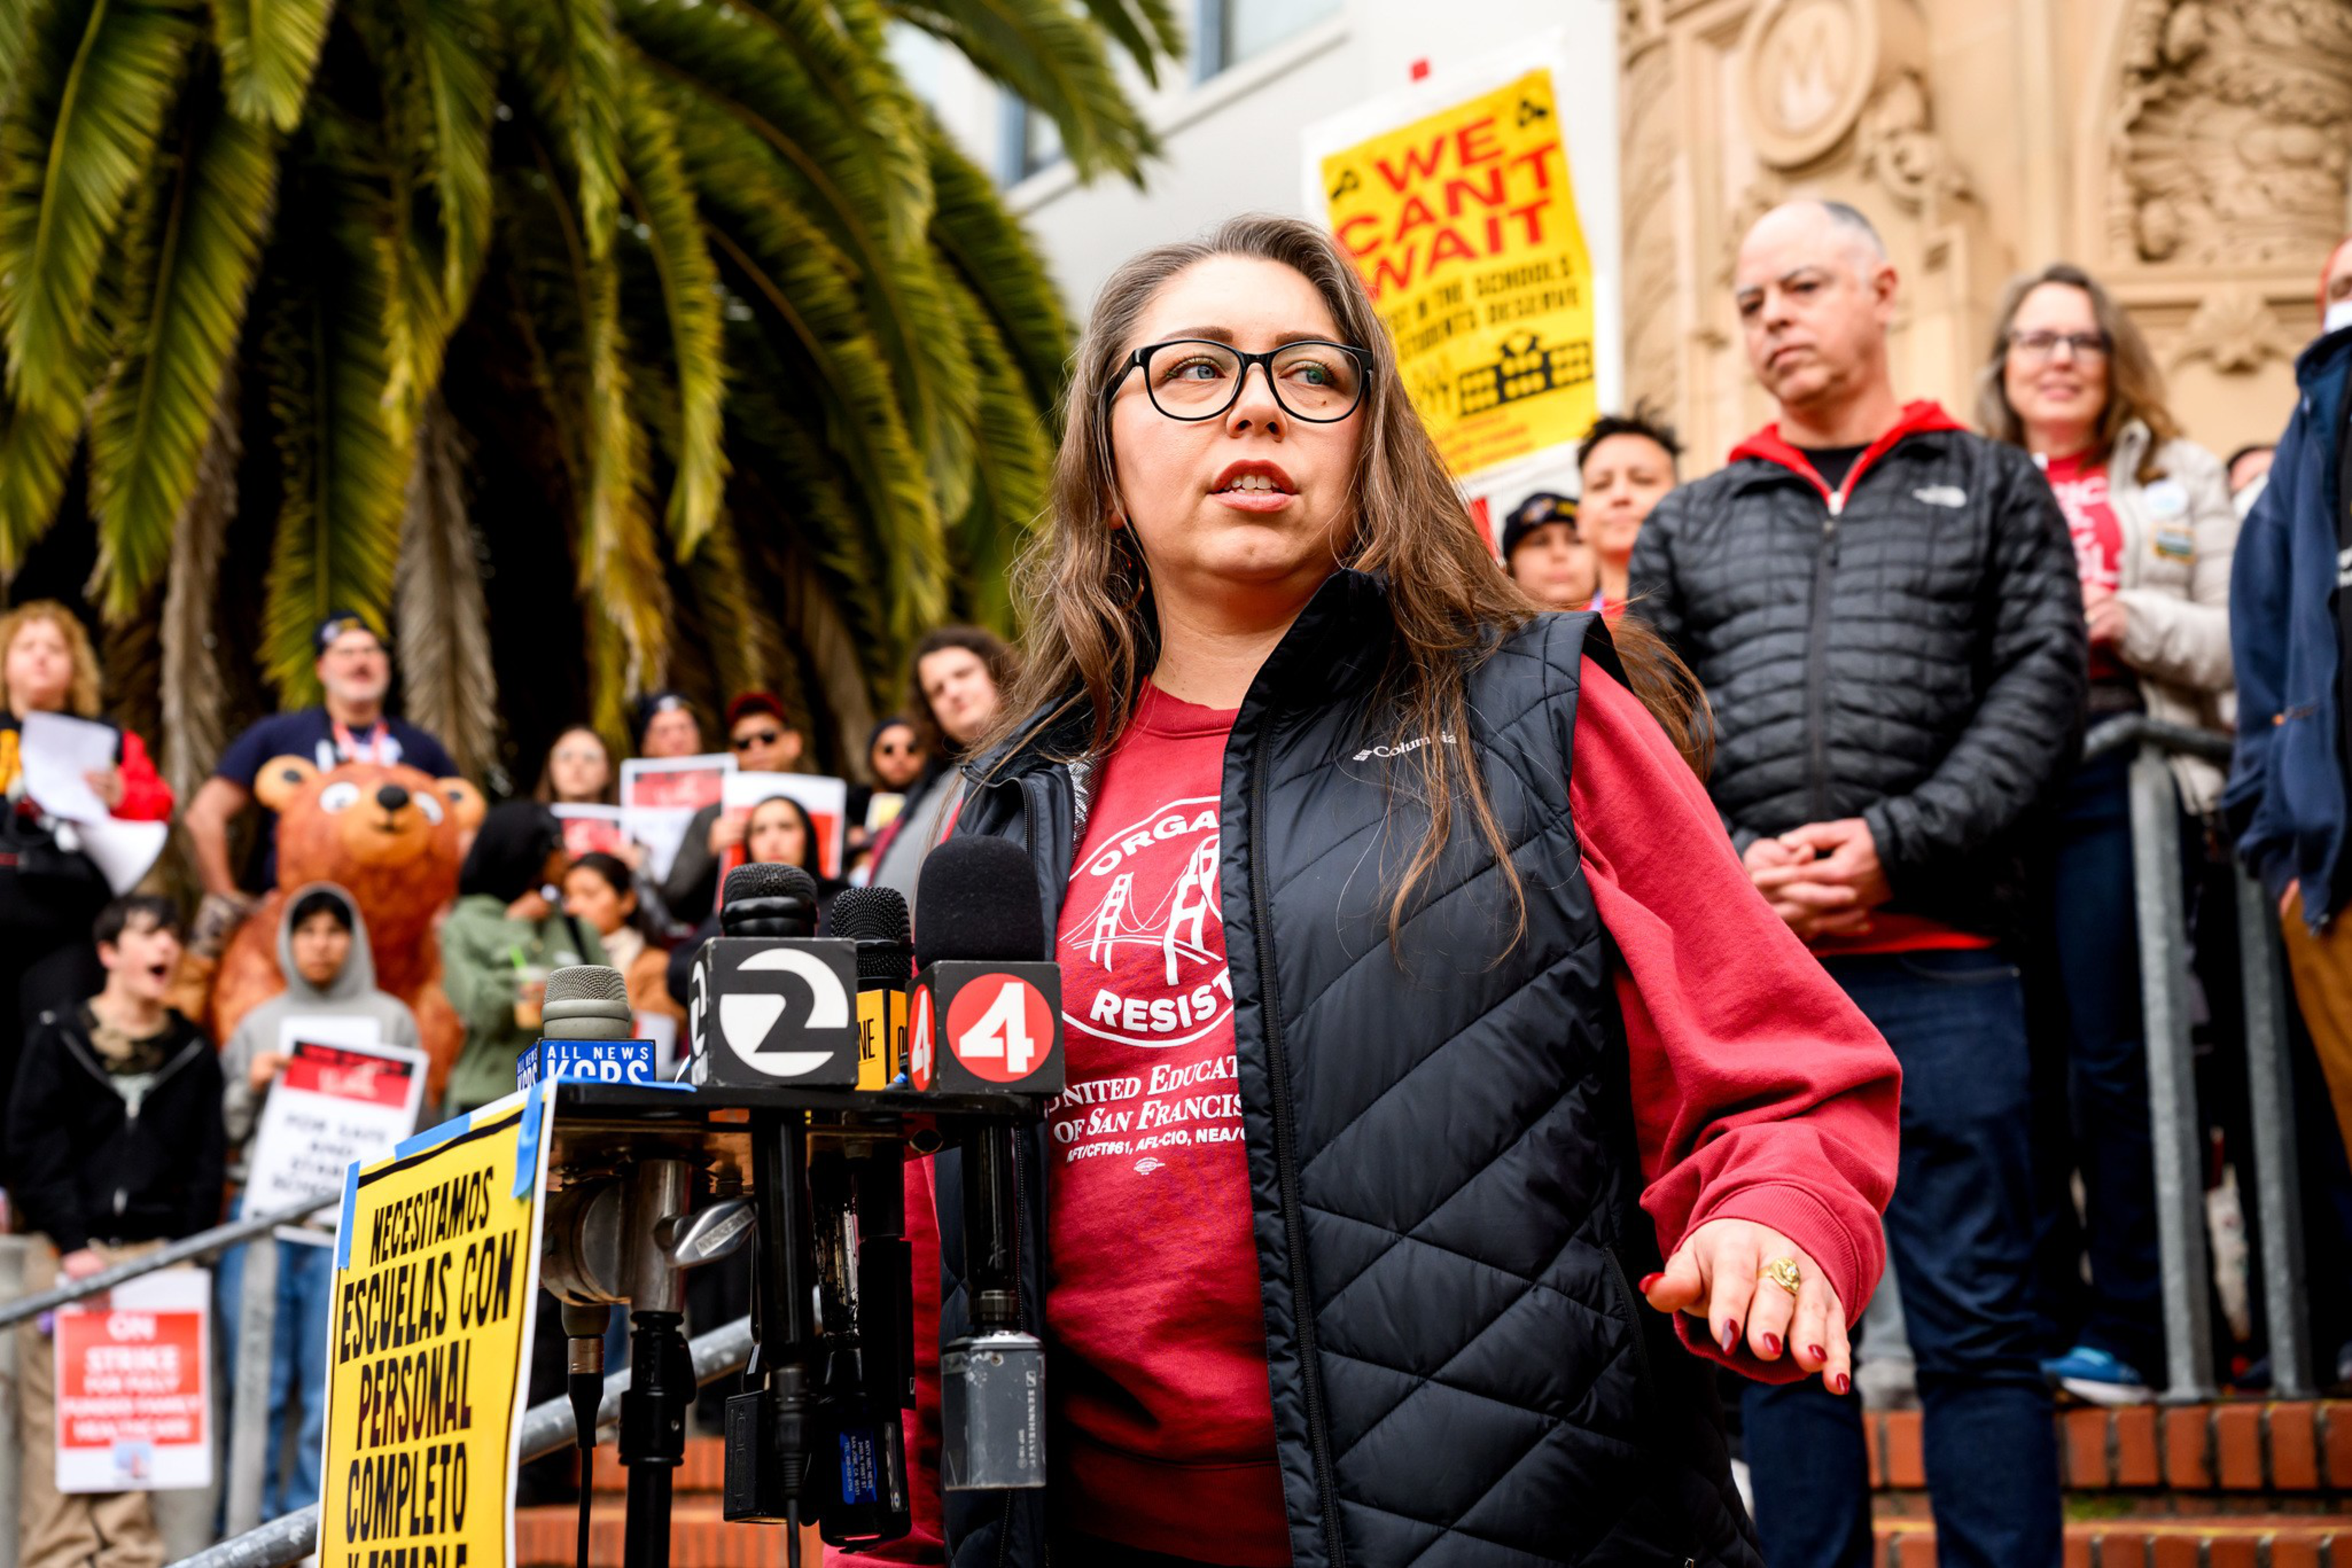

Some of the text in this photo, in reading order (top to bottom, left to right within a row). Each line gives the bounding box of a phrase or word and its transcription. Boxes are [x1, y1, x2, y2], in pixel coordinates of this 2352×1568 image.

[1375, 116, 1504, 192] WE
[1336, 141, 1557, 257] CANT
[1363, 198, 1551, 301] WAIT
[1475, 255, 1573, 298] SCHOOLS
[1488, 285, 1579, 325] DESERVE
[1373, 731, 1457, 758] Columia
[1090, 810, 1220, 876] ORGA
[719, 948, 849, 1077] 2
[959, 982, 1035, 1073] 4
[1089, 967, 1233, 1033] RESIST
[546, 1046, 649, 1060] ALL NEWS
[912, 990, 931, 1082] 4
[1147, 1055, 1238, 1096] EDUCAT
[1053, 1119, 1085, 1144] OF
[1086, 1107, 1133, 1136] SAN
[1136, 1129, 1192, 1152] AFL-CIO,
[370, 1165, 494, 1267] NECESITAMOS
[106, 1310, 156, 1341] ON
[339, 1229, 518, 1365] ESCUELAS CON
[85, 1344, 180, 1374] STRIKE
[357, 1338, 472, 1452] PERSONAL
[346, 1441, 467, 1544] COMPLETO
